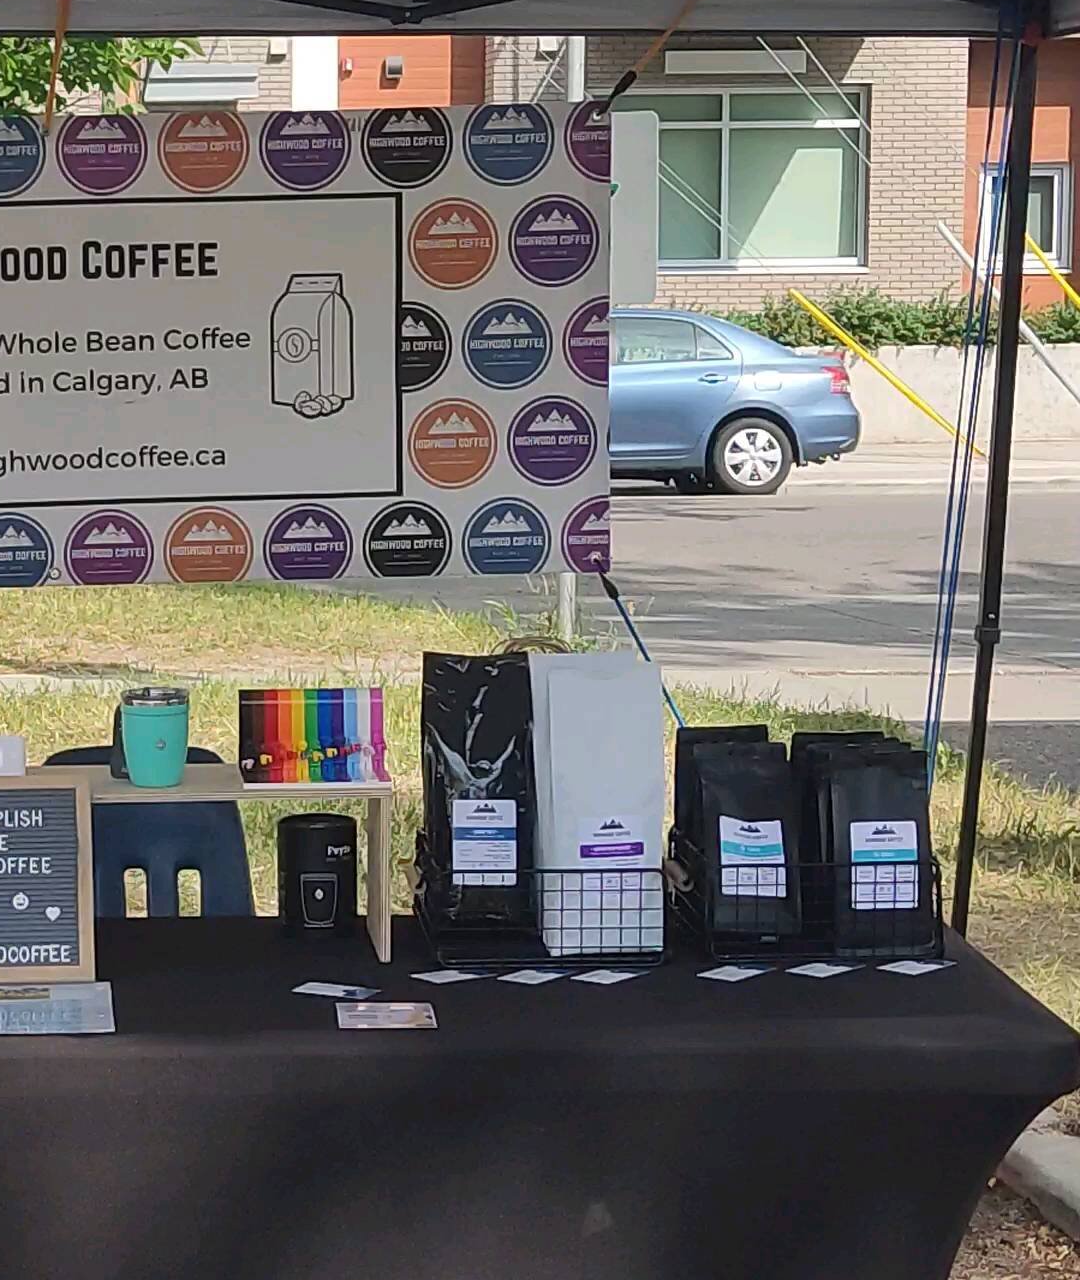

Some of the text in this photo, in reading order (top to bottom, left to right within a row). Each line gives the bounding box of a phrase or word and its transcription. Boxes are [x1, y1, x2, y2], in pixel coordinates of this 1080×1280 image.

[81, 240, 219, 280] COFFEE
[86, 330, 155, 353] Bean
[163, 327, 251, 351] Coffee
[20, 370, 44, 393] in
[52, 369, 162, 396] Calgary,
[169, 368, 209, 390] AB
